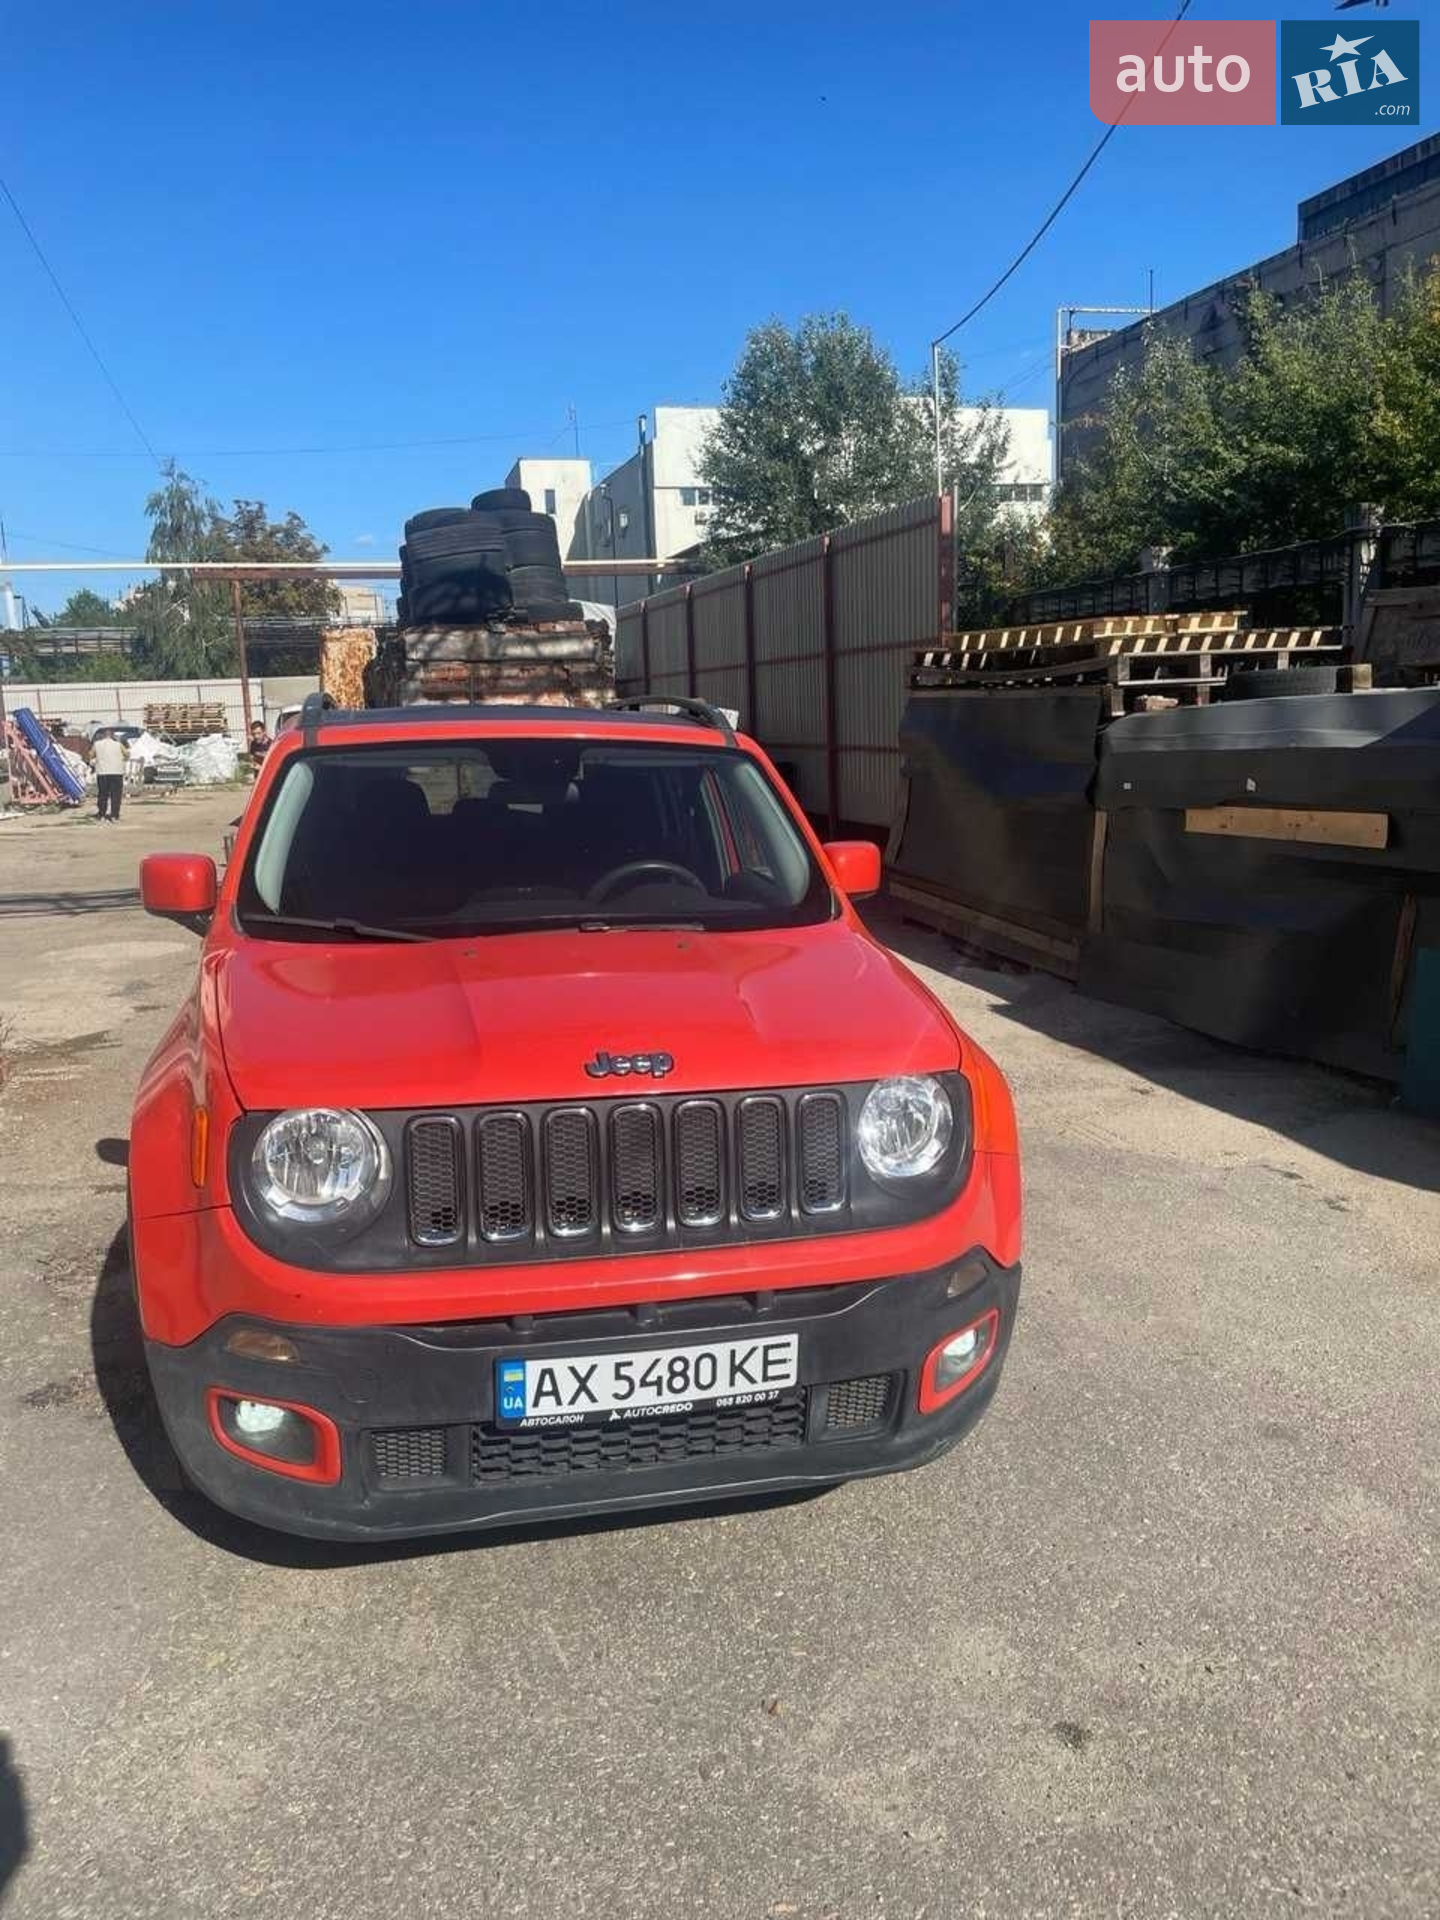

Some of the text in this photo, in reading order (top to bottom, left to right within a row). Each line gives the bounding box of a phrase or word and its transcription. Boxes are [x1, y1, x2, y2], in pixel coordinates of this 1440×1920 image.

[584, 1052, 674, 1079] Jeep
[532, 1341, 791, 1408] AX 5480 KE
[503, 1397, 523, 1410] UA
[623, 1402, 693, 1419] AUTOCREDO
